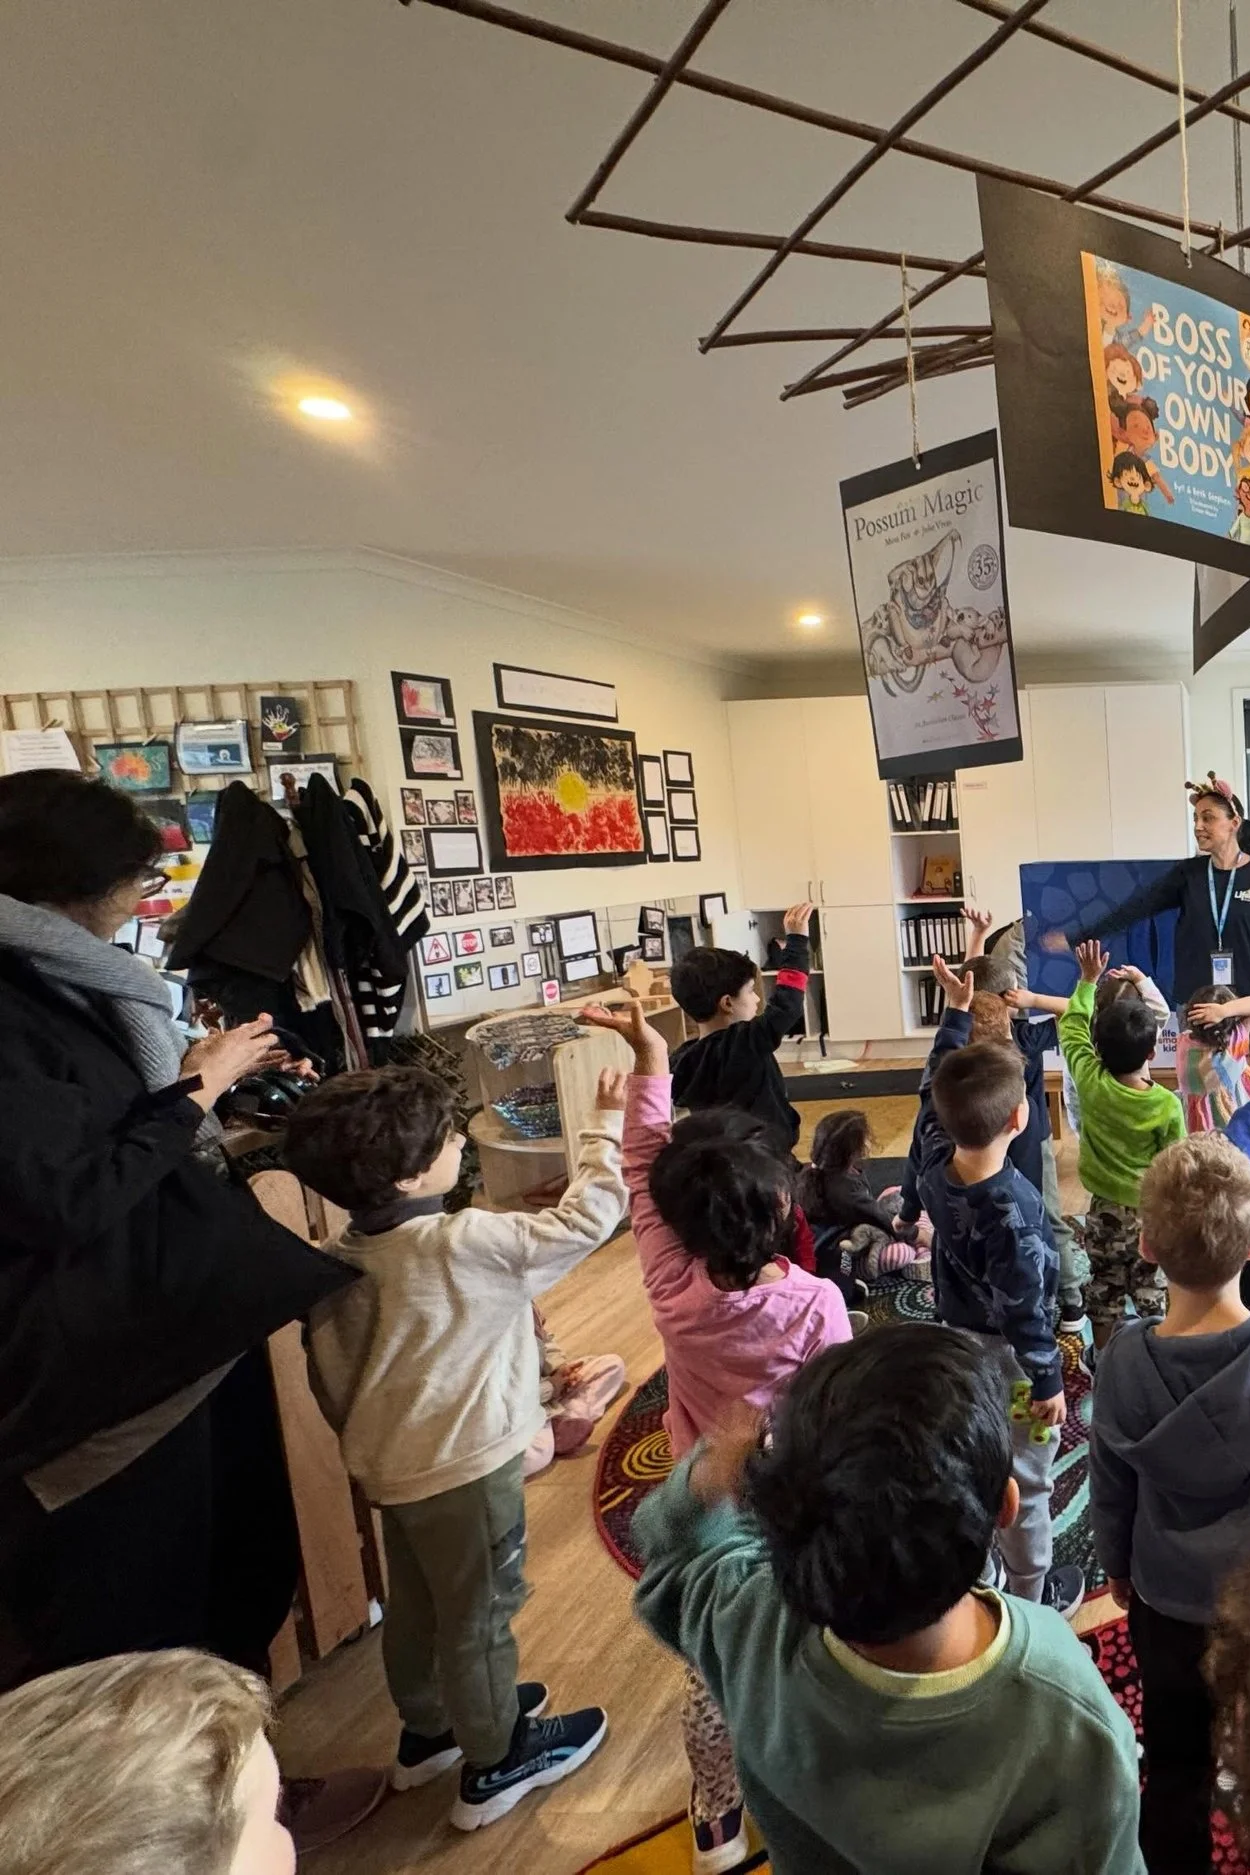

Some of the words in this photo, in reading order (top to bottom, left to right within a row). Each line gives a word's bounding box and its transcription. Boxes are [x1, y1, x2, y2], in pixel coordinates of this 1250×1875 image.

[1151, 302, 1233, 370] BOSS
[1135, 346, 1171, 382] OF
[1174, 355, 1250, 415] YOUR
[1165, 392, 1231, 445] OWN
[1159, 428, 1234, 488] BODY
[854, 506, 917, 541] Possum
[922, 480, 984, 516] Magic
[1161, 1029, 1176, 1037] life
